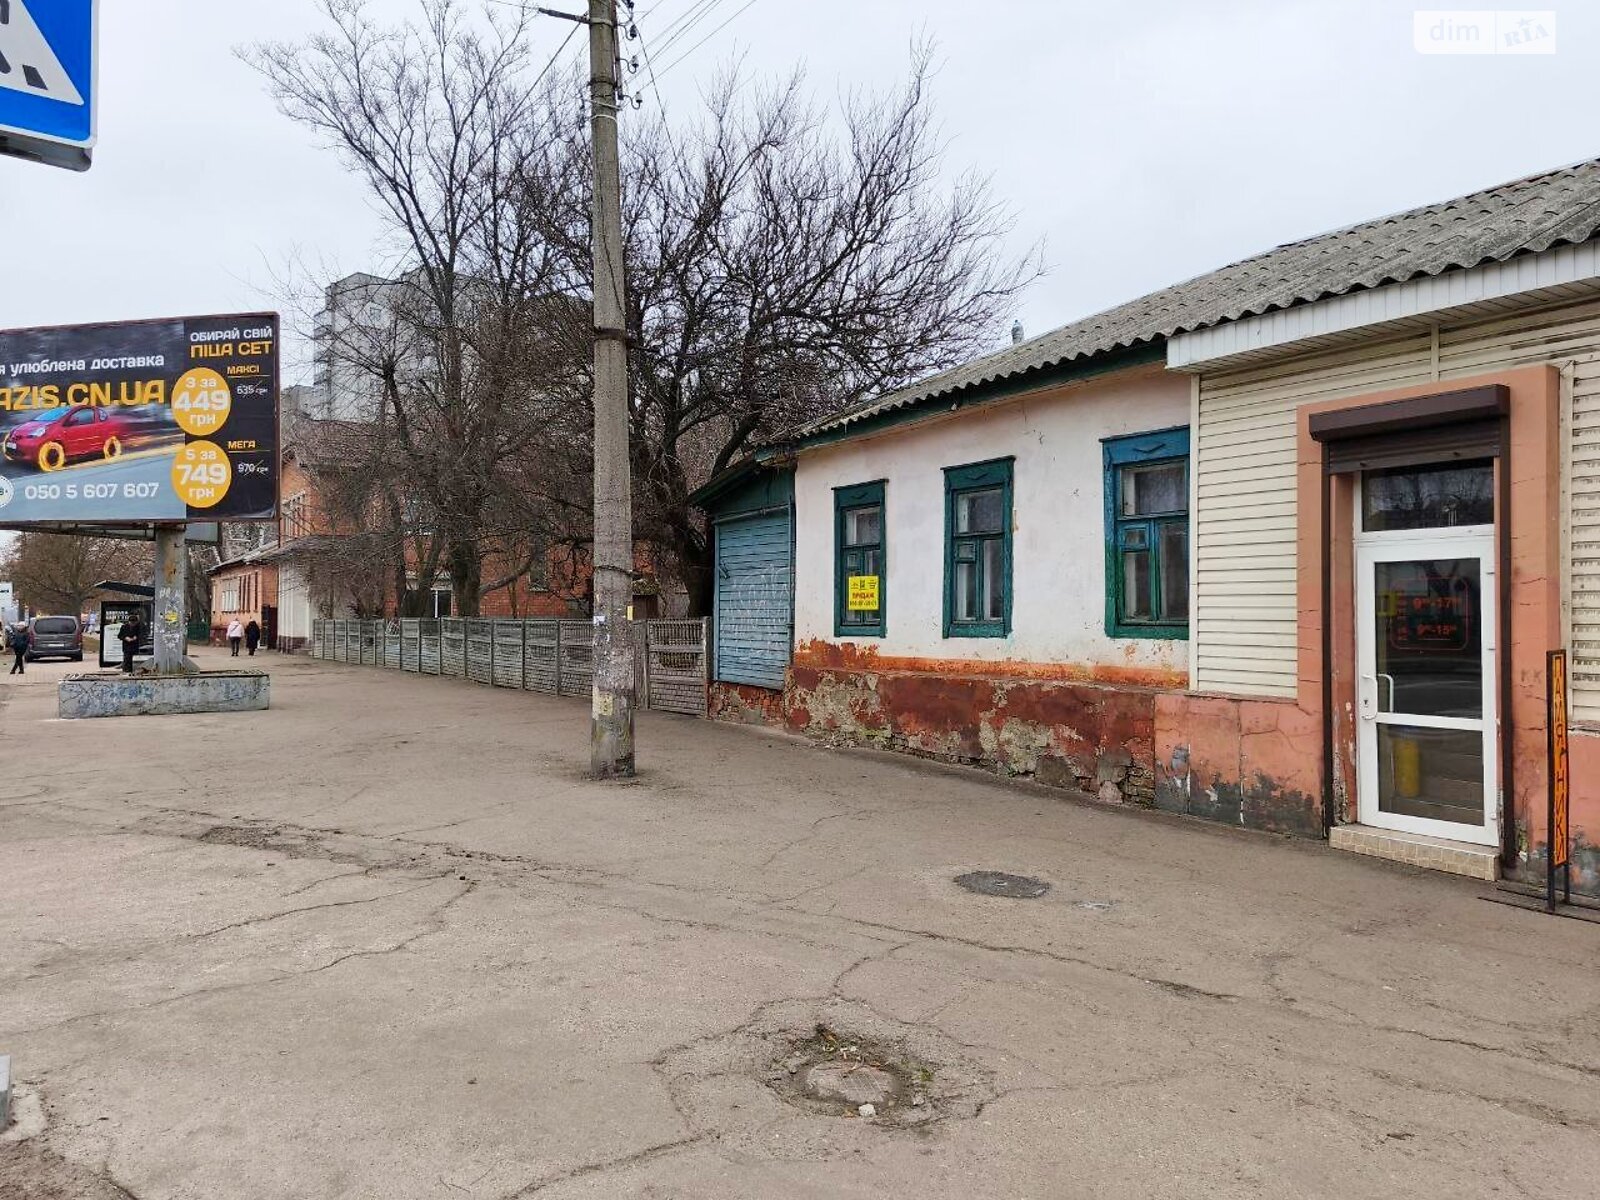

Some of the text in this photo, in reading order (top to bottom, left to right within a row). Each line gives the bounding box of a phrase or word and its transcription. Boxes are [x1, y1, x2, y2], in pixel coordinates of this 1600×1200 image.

[190, 325, 273, 342] ОБИРАЙ СВІЙ
[190, 340, 273, 358] ПІЦА СЕТ
[10, 358, 86, 377] улюблена
[90, 355, 165, 370] доставка
[227, 364, 260, 375] МАКСІ
[199, 378, 217, 389] за
[174, 390, 230, 412] 449
[189, 413, 216, 428] грн
[228, 440, 256, 449] МЕГА
[185, 449, 217, 460] 5 за
[176, 463, 227, 486] 749
[24, 483, 61, 500] 050
[65, 484, 79, 499] 5
[83, 483, 118, 499] 607
[123, 482, 160, 498] 607
[189, 487, 215, 500] грн
